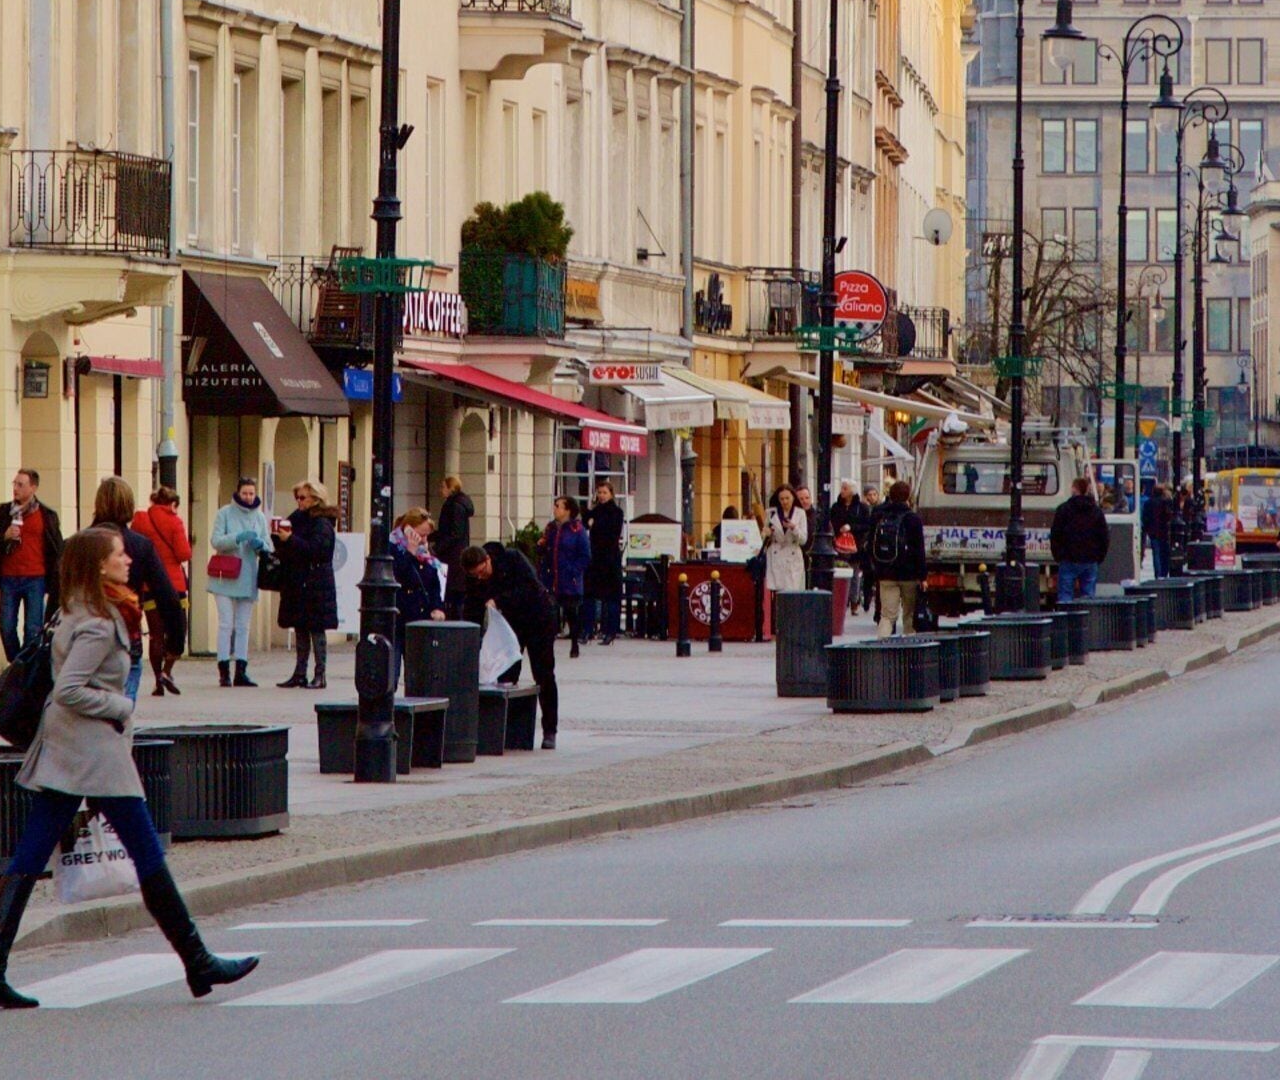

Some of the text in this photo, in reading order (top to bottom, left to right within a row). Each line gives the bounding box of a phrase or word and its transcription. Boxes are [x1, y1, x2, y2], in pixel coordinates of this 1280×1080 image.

[839, 280, 869, 294] Pizza
[426, 290, 462, 335] COFFEE
[940, 528, 978, 540] HALE
[61, 851, 102, 866] GREY
